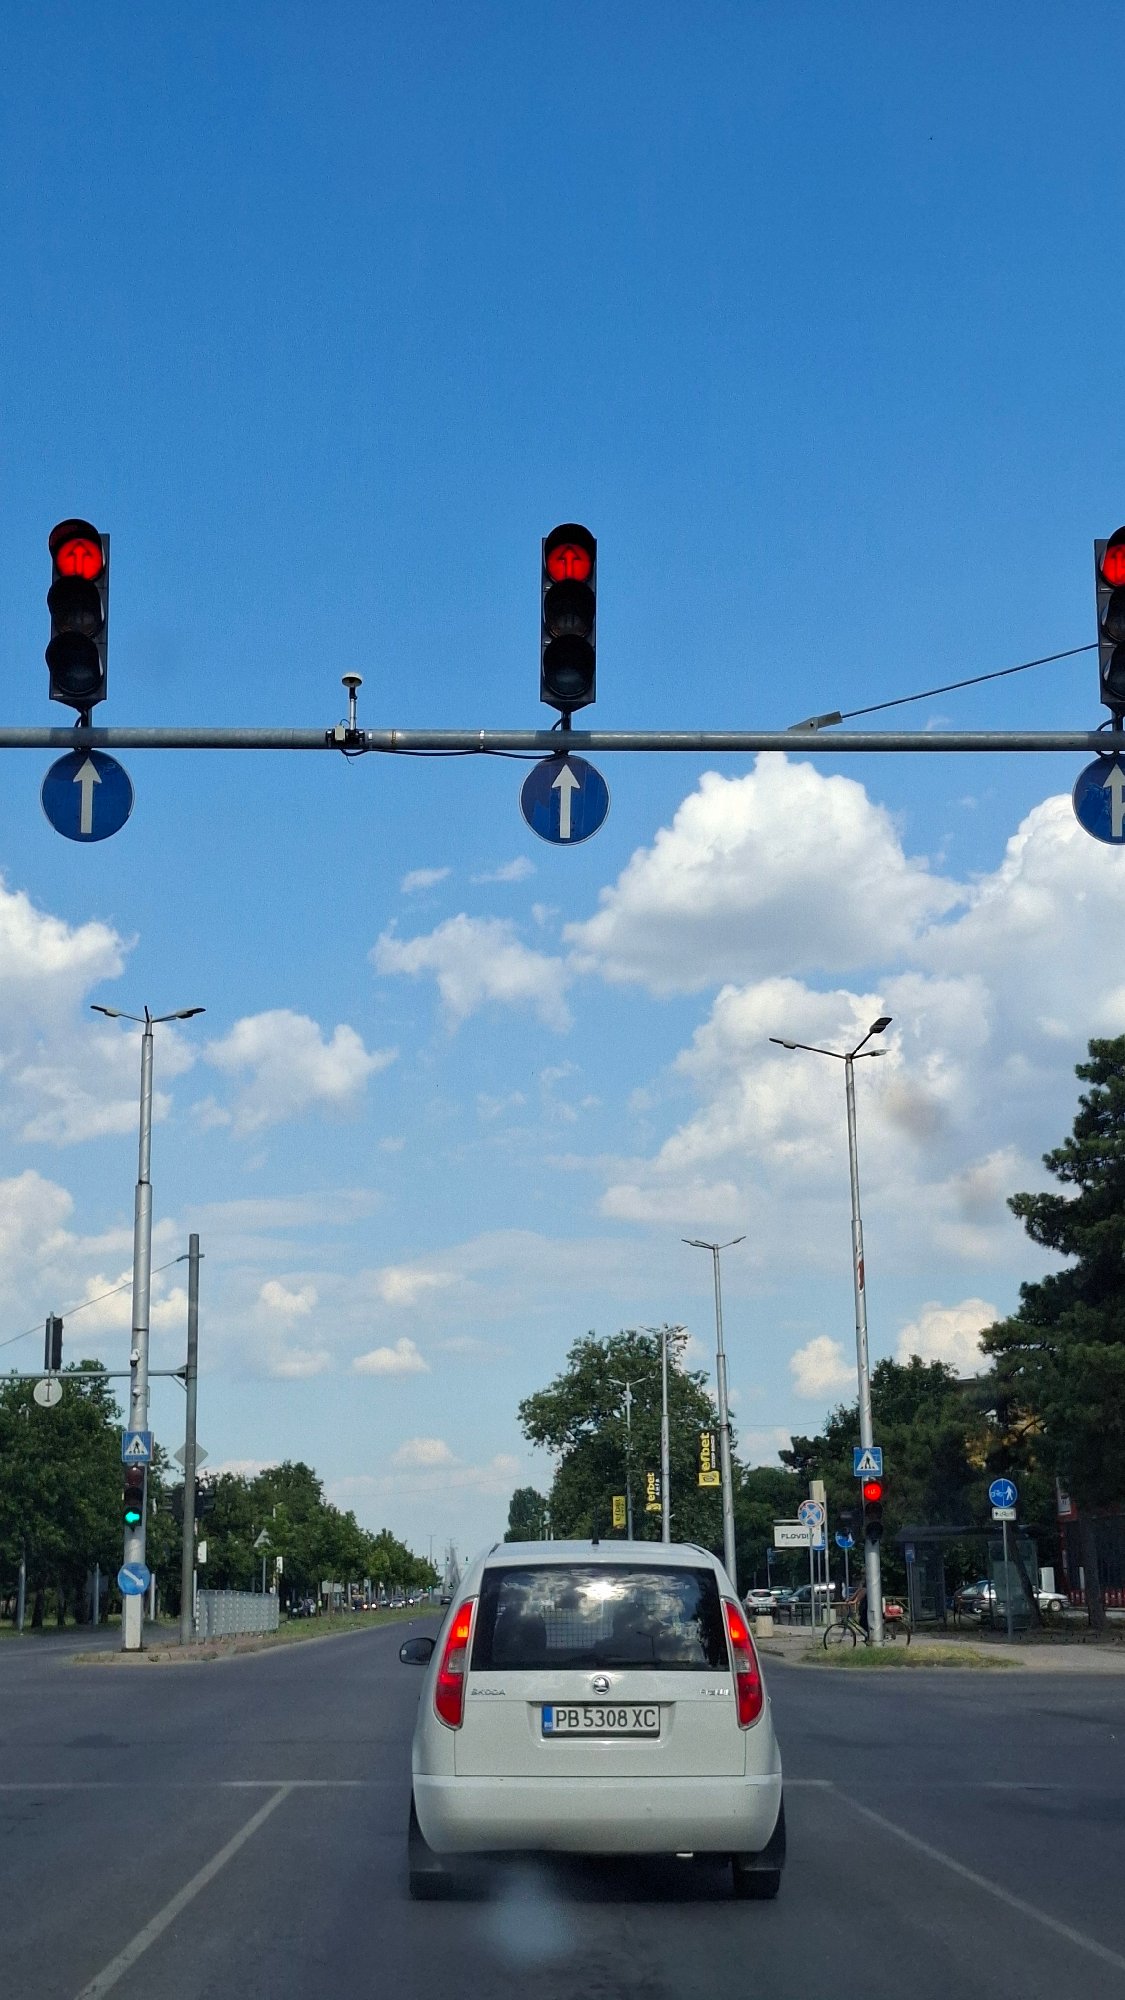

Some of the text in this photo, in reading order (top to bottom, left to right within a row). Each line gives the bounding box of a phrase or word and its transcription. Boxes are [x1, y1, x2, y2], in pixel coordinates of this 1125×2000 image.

[700, 1432, 710, 1471] efbet
[646, 1472, 655, 1501] efbet
[556, 1709, 656, 1728] PB 5308 XC
